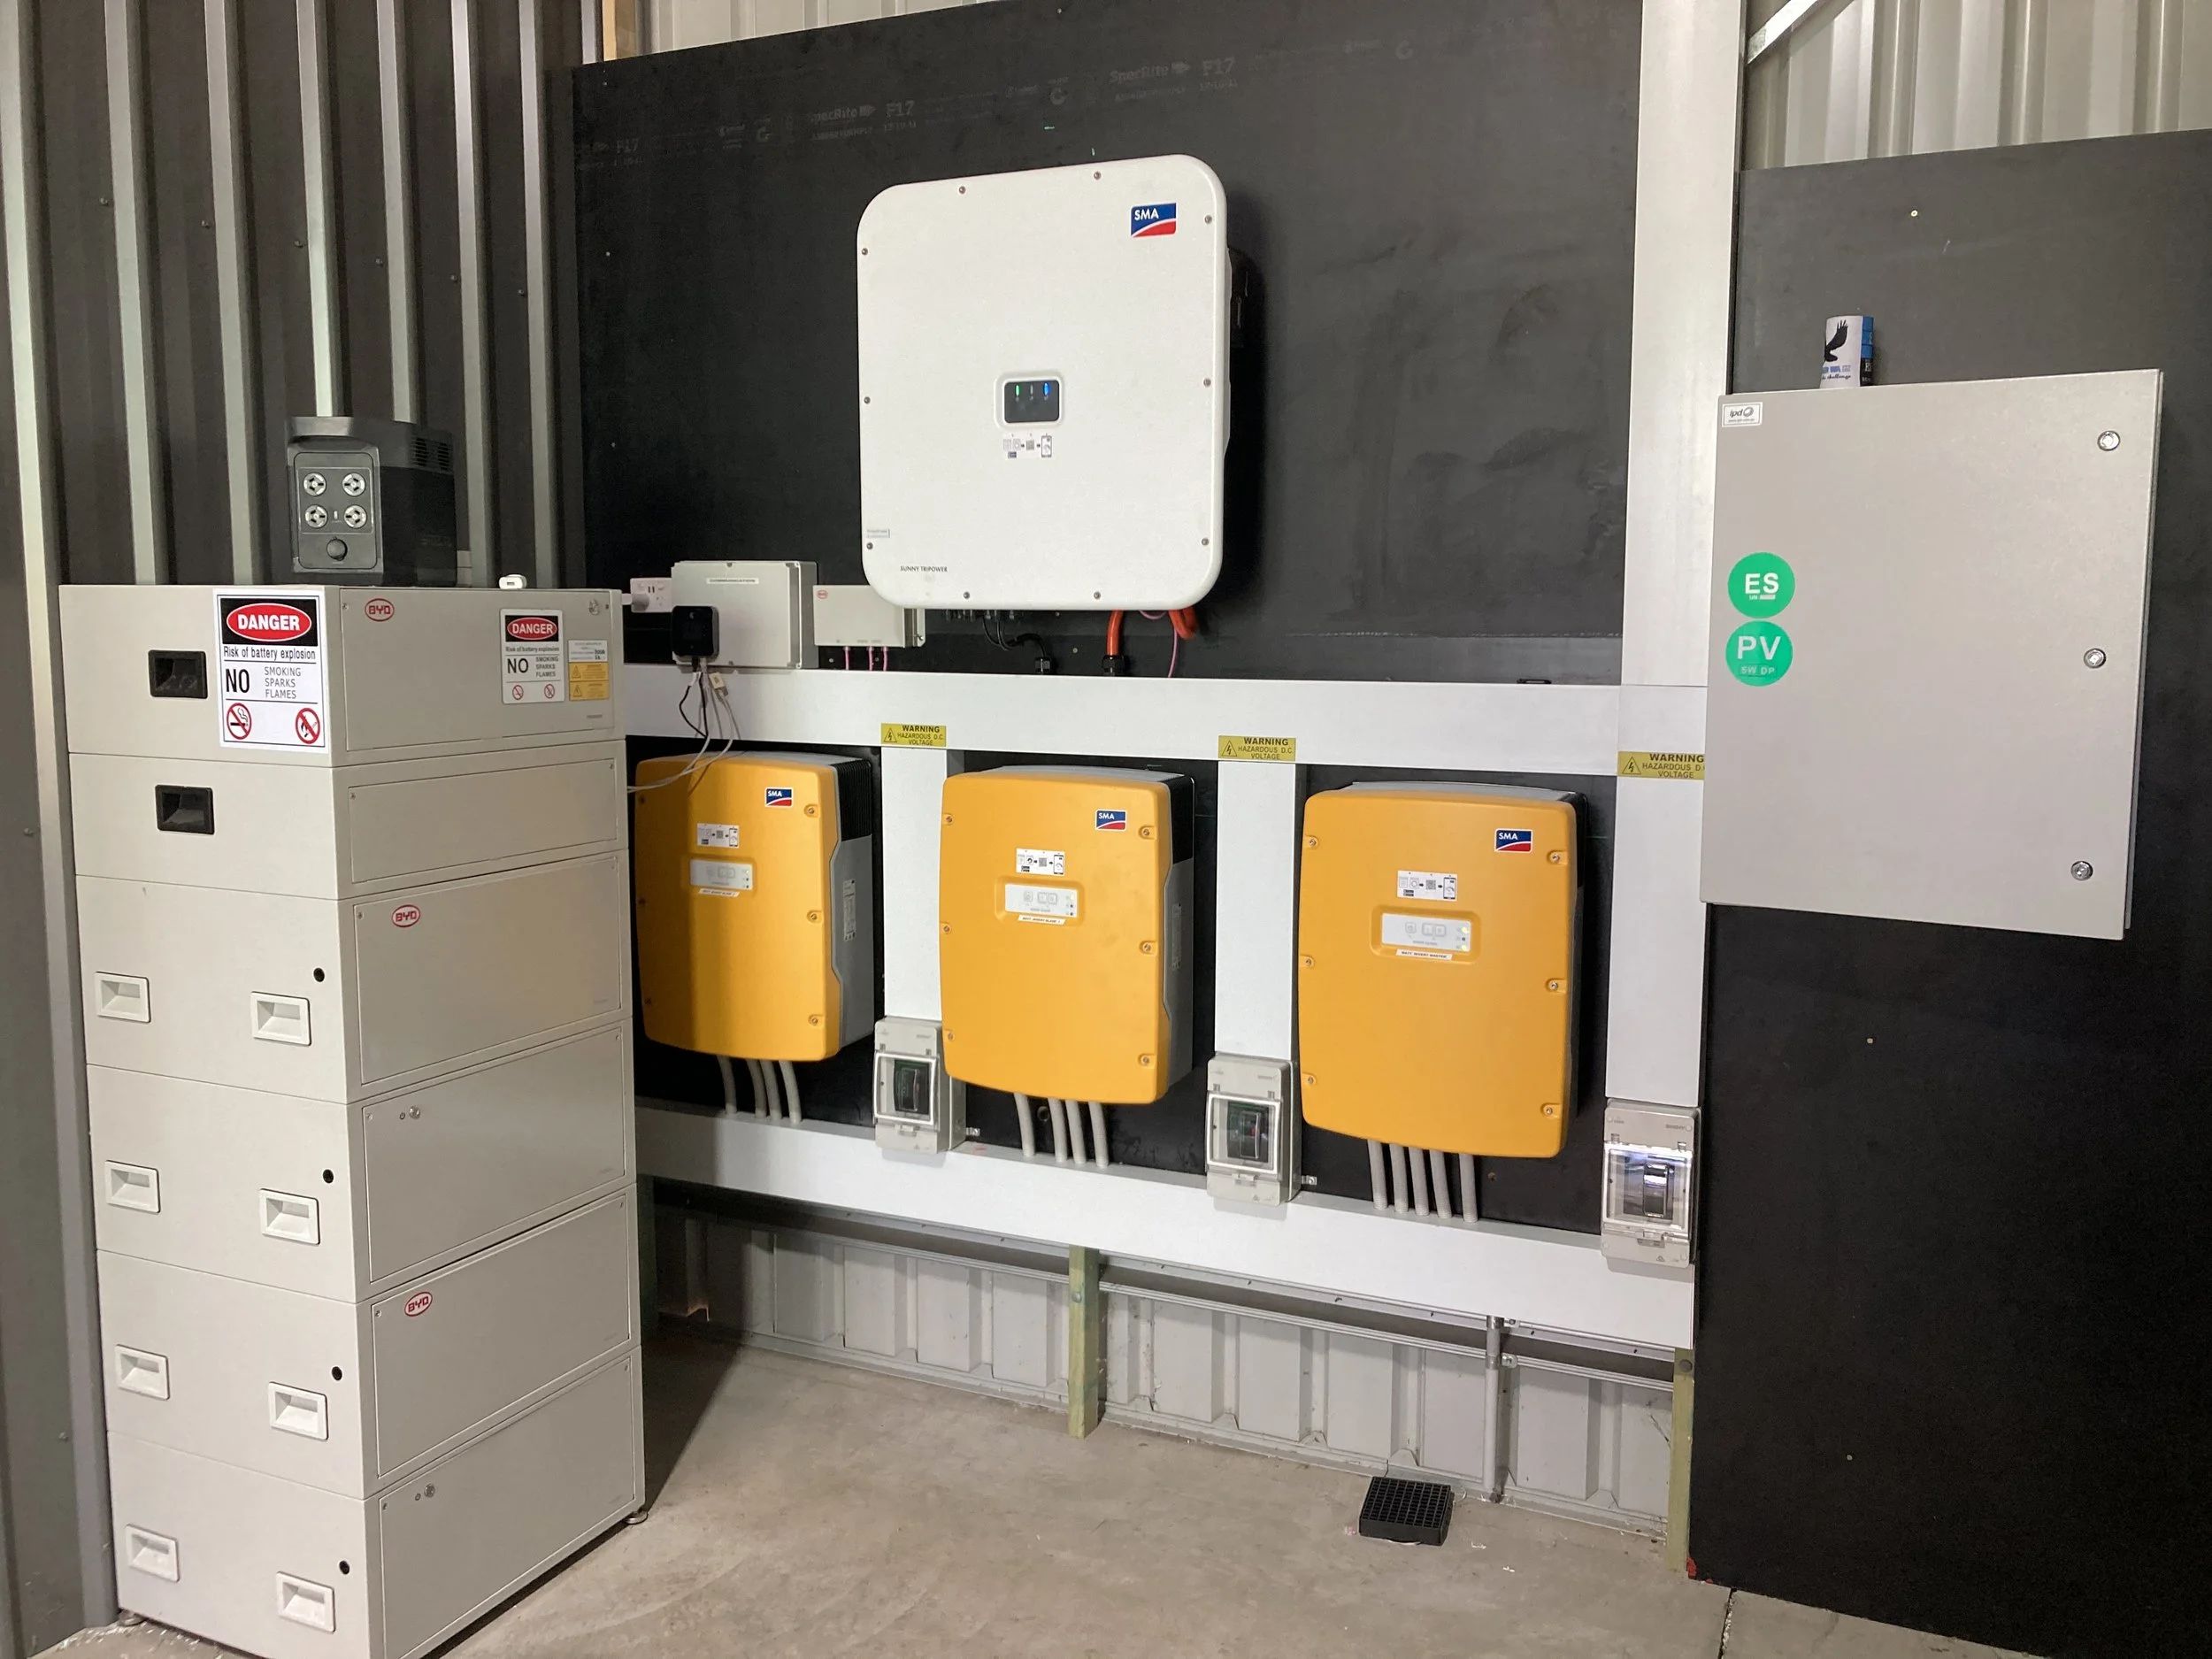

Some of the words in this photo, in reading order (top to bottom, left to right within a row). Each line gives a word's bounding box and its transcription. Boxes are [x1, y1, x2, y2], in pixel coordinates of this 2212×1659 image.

[886, 100, 915, 118] F17
[1133, 208, 1159, 221] SMA
[1746, 572, 1779, 594] ES
[369, 605, 391, 614] BYD
[237, 614, 300, 631] DANGER
[512, 623, 553, 634] DANGER
[224, 646, 239, 657] Risk
[242, 647, 249, 658] of
[251, 647, 277, 662] battery
[280, 649, 316, 663] explosion
[1737, 635, 1781, 661] PV
[265, 666, 301, 676] SMOKING
[507, 657, 529, 674] NO
[226, 668, 250, 694] NO
[265, 678, 296, 687] SPARKS
[265, 689, 296, 699] FLAMES
[1244, 737, 1288, 746] WARNING
[1649, 753, 1704, 763] WARNING
[396, 910, 417, 922] BYD
[408, 1295, 429, 1312] BYD
